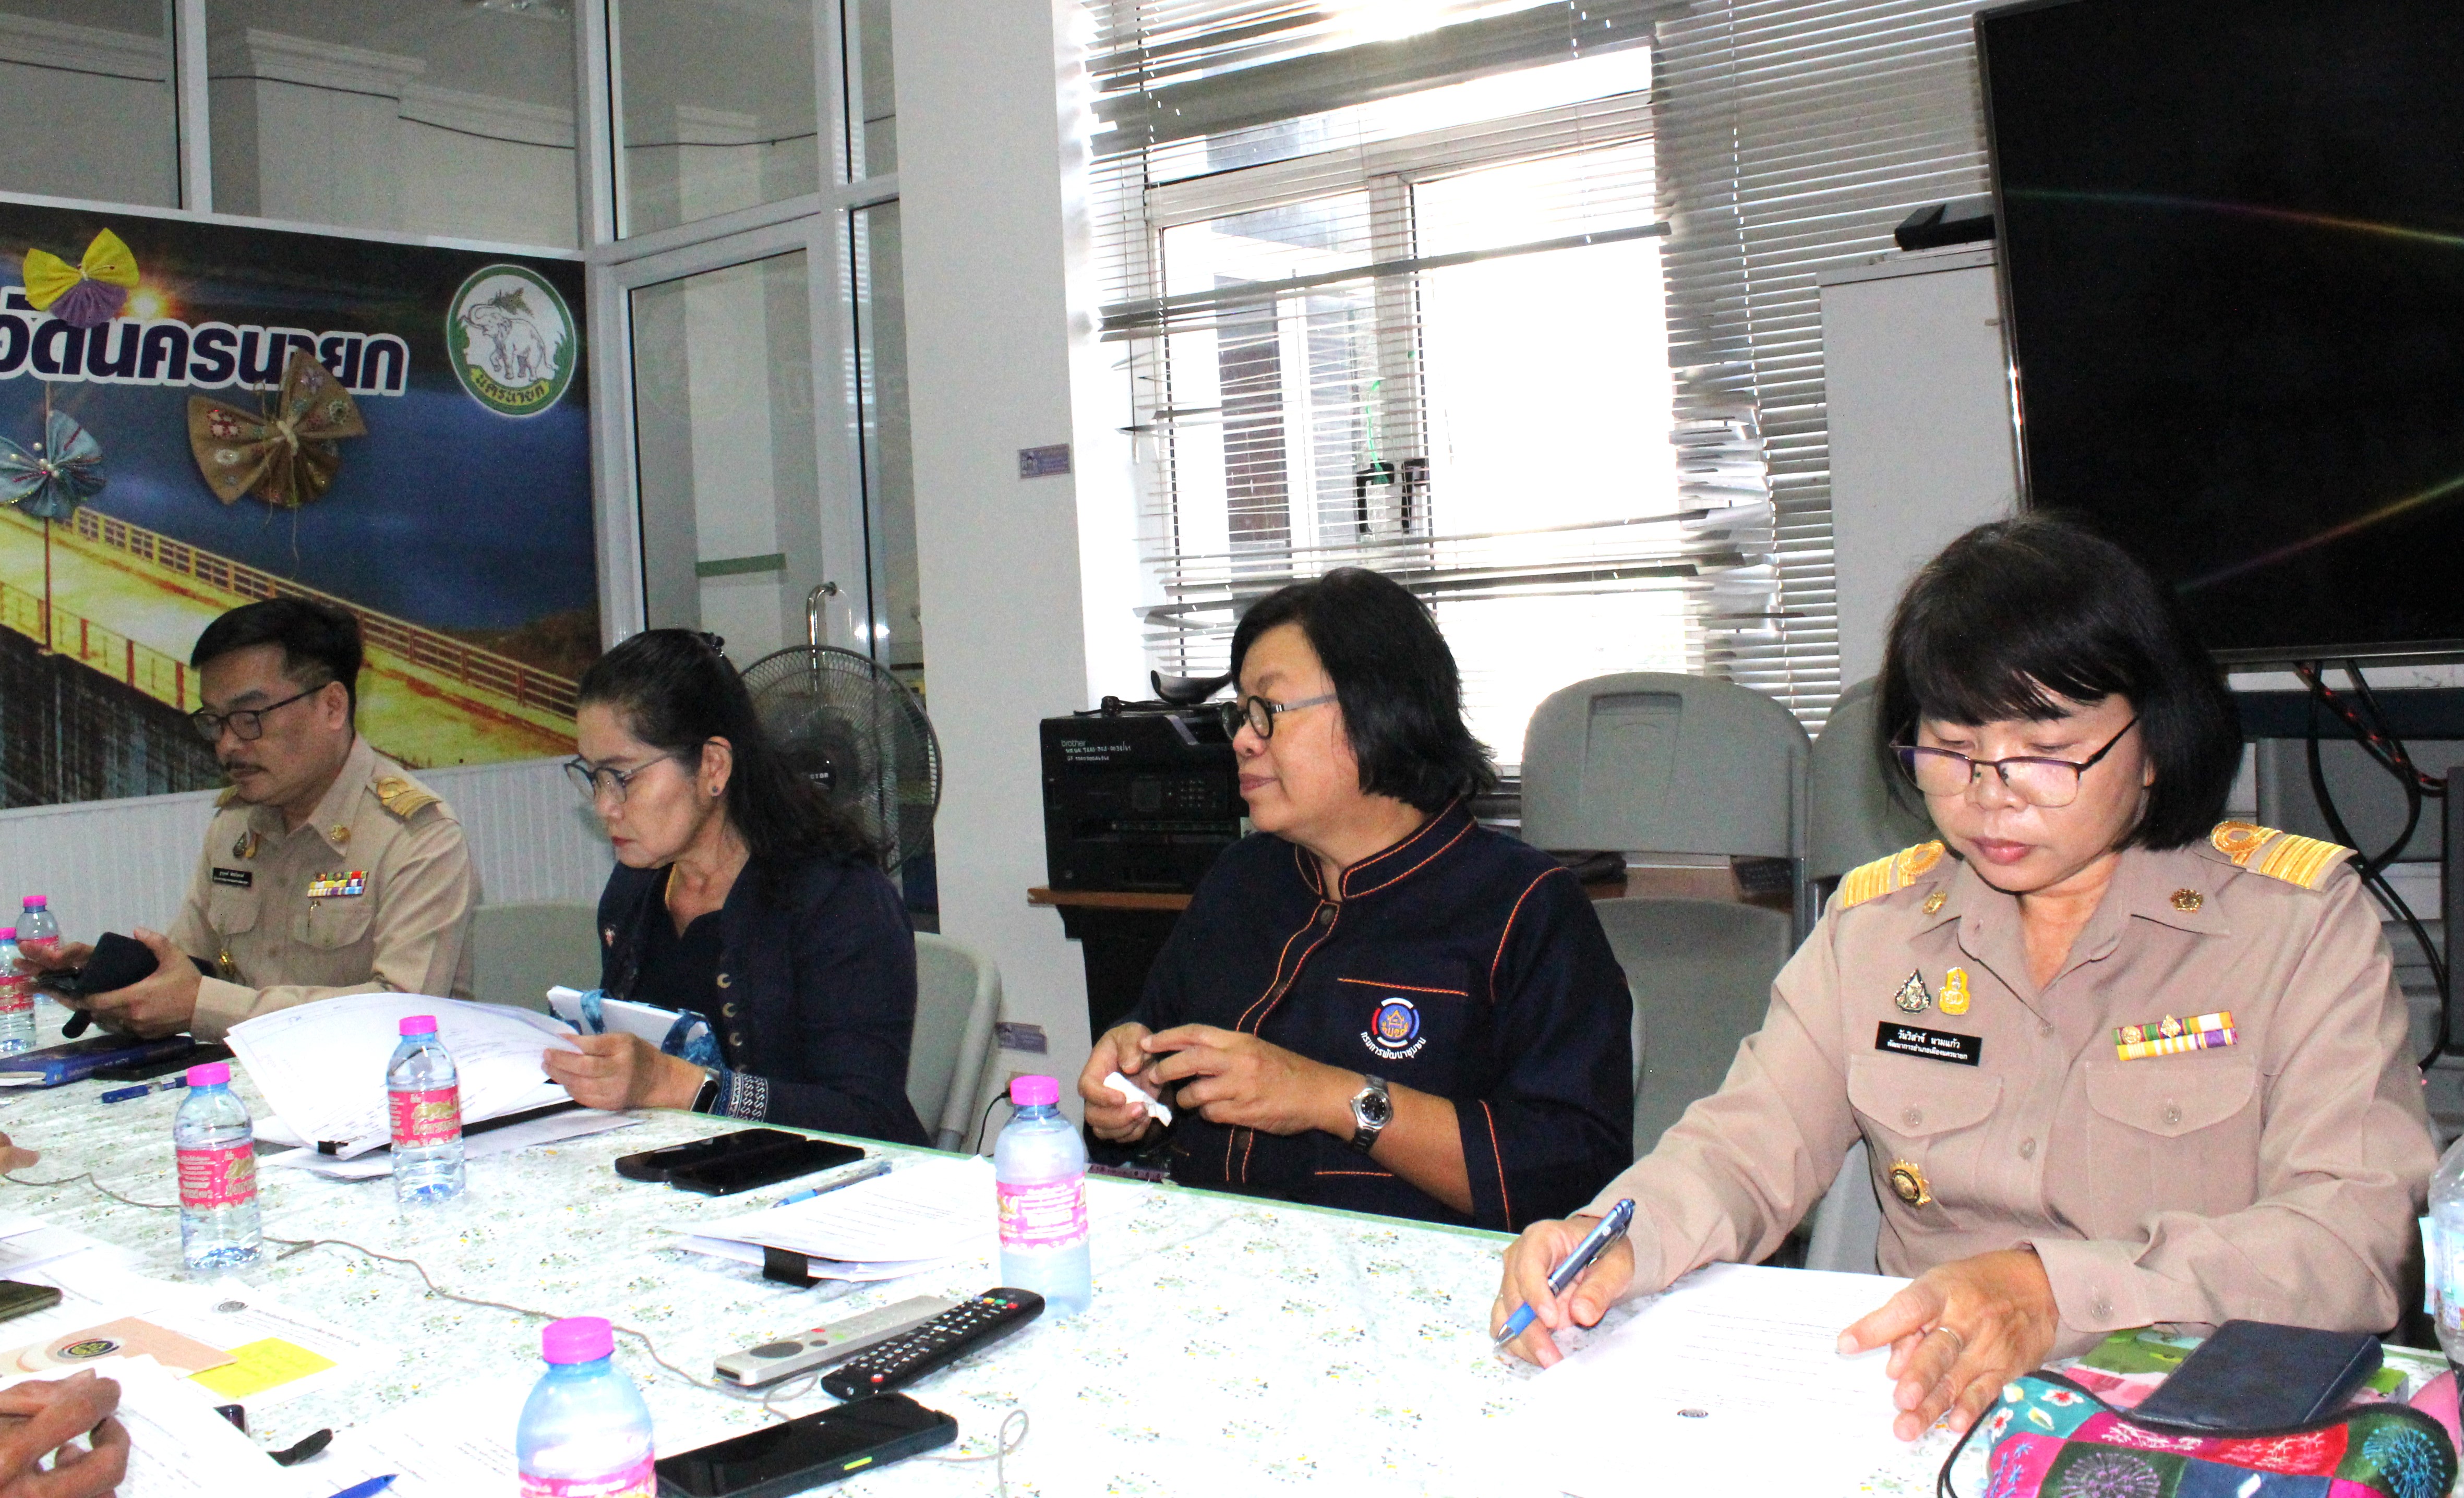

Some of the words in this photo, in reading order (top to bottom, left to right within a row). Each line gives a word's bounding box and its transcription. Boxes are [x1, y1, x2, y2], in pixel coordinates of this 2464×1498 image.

[475, 373, 546, 404] นครนายก
[1360, 1031, 1427, 1059] กรมการพัฒนาชุมชน
[1931, 1037, 1960, 1049] นามแก้ว
